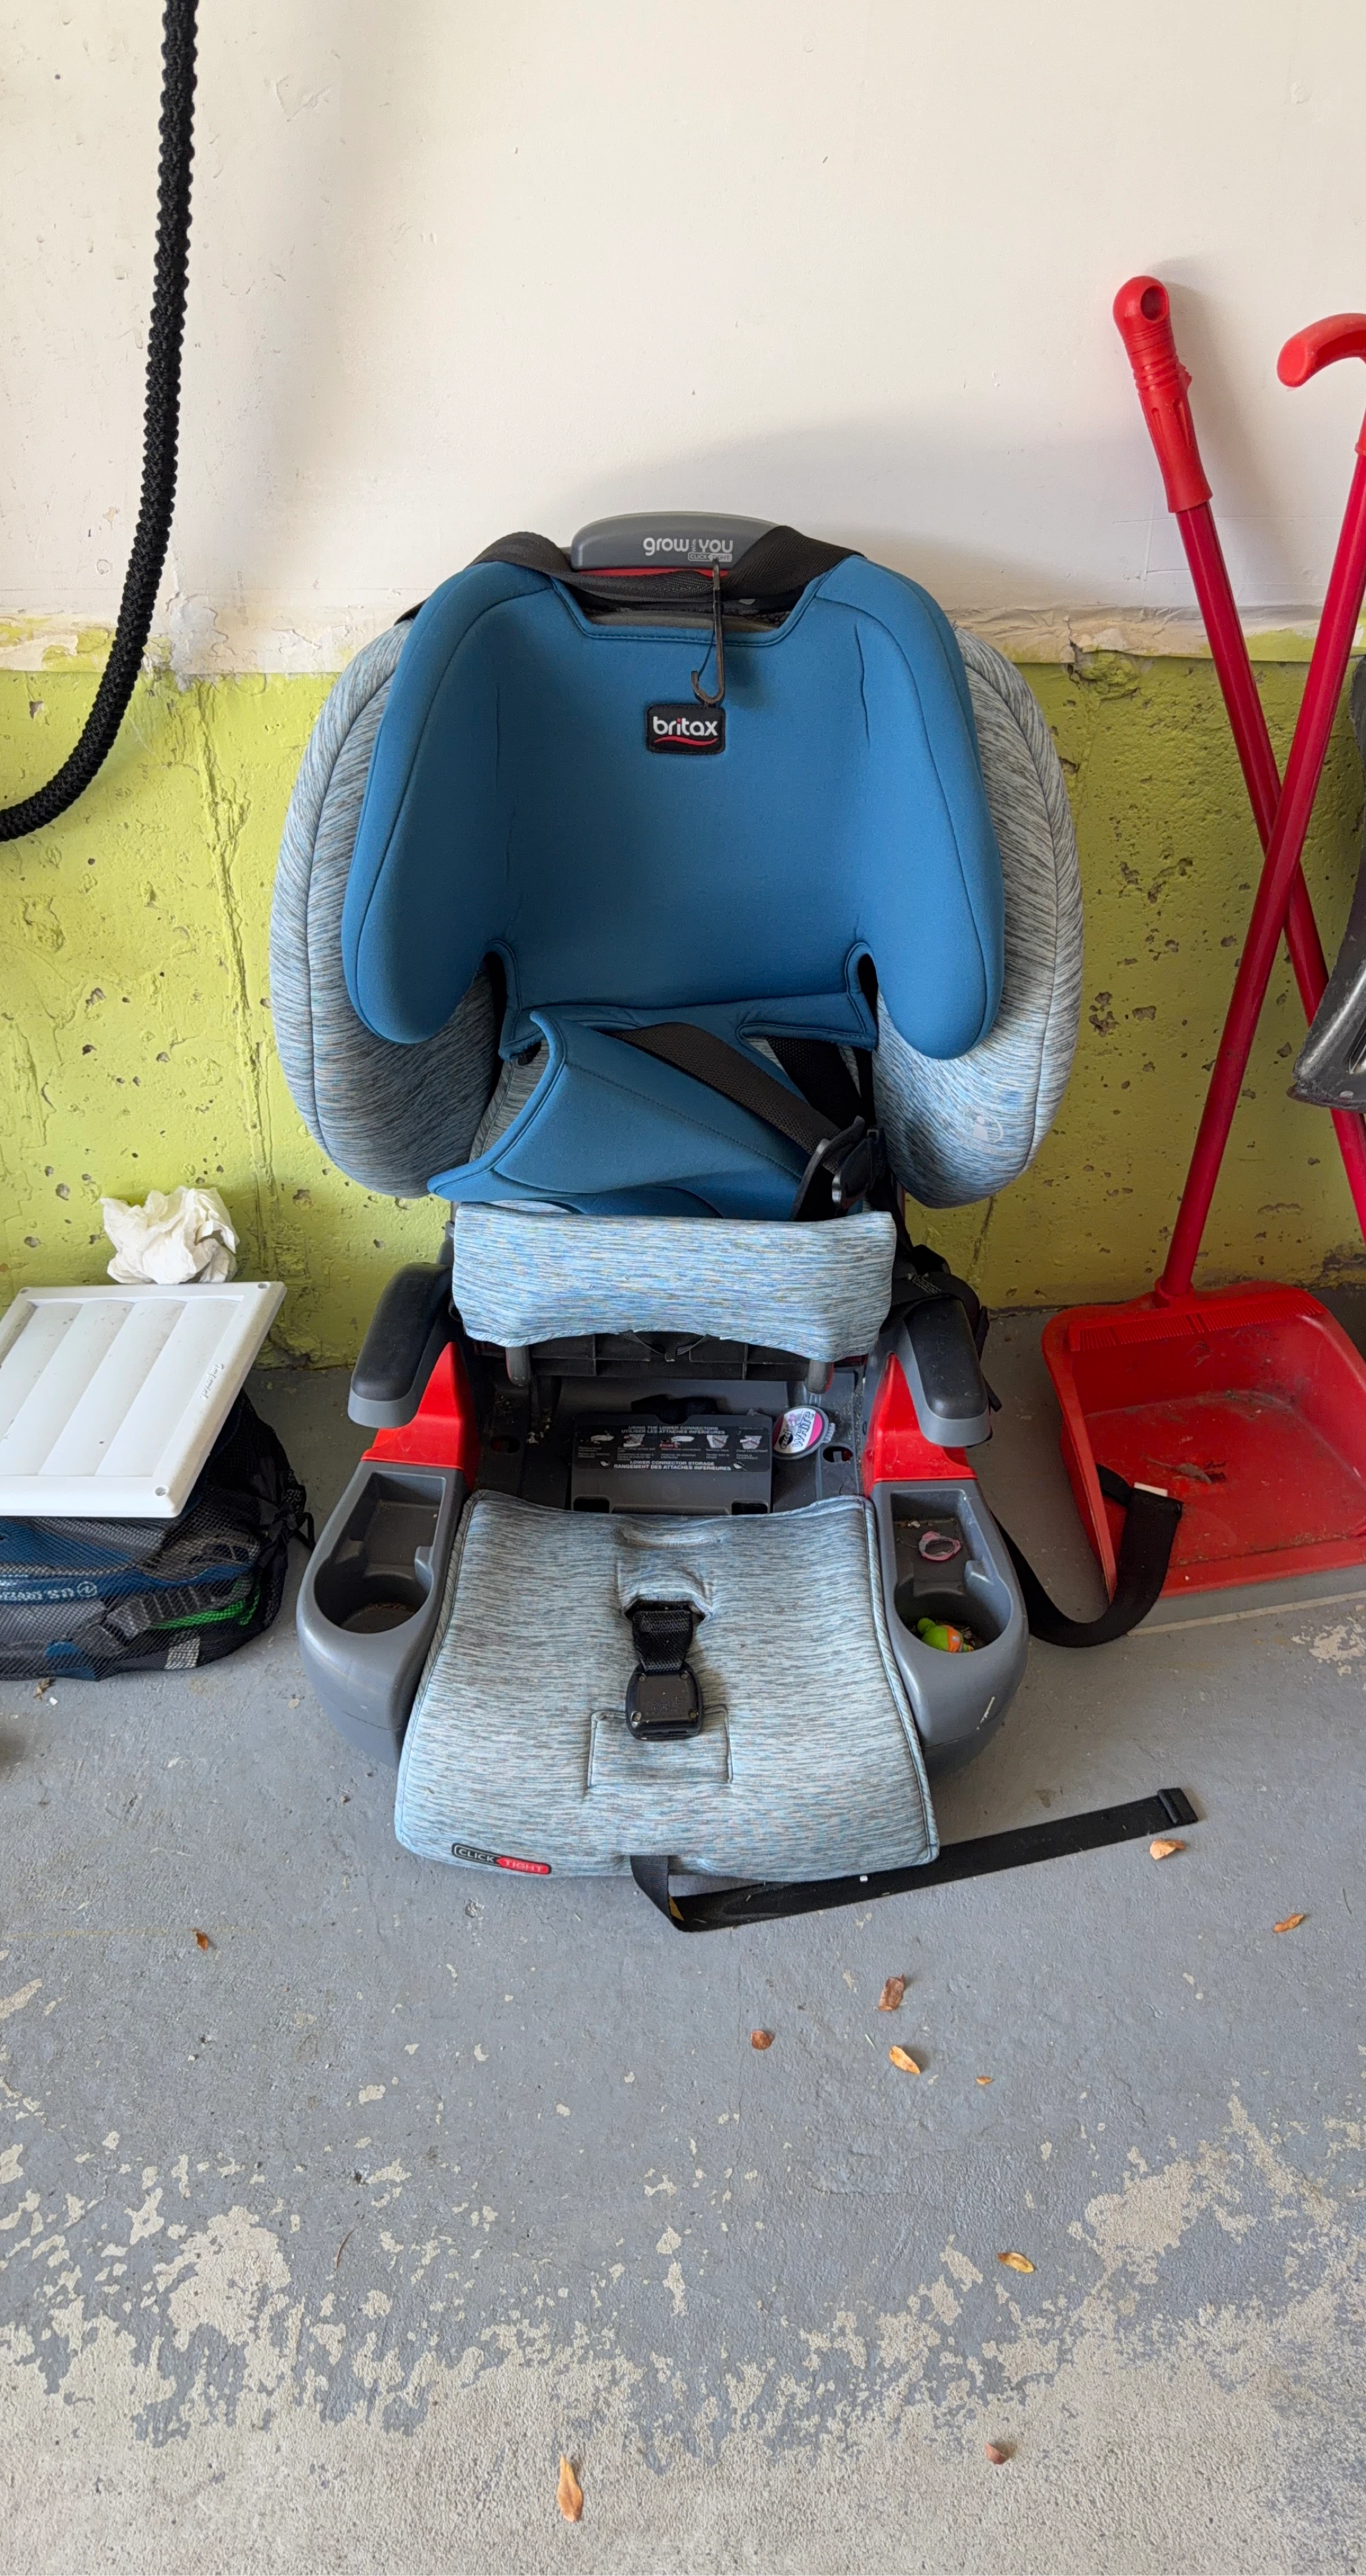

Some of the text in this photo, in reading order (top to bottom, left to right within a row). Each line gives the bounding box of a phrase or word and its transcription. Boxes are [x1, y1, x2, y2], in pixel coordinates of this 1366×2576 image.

[643, 537, 689, 556] grow
[653, 716, 718, 736] britax
[458, 1849, 542, 1872] CLICK TIGHT
